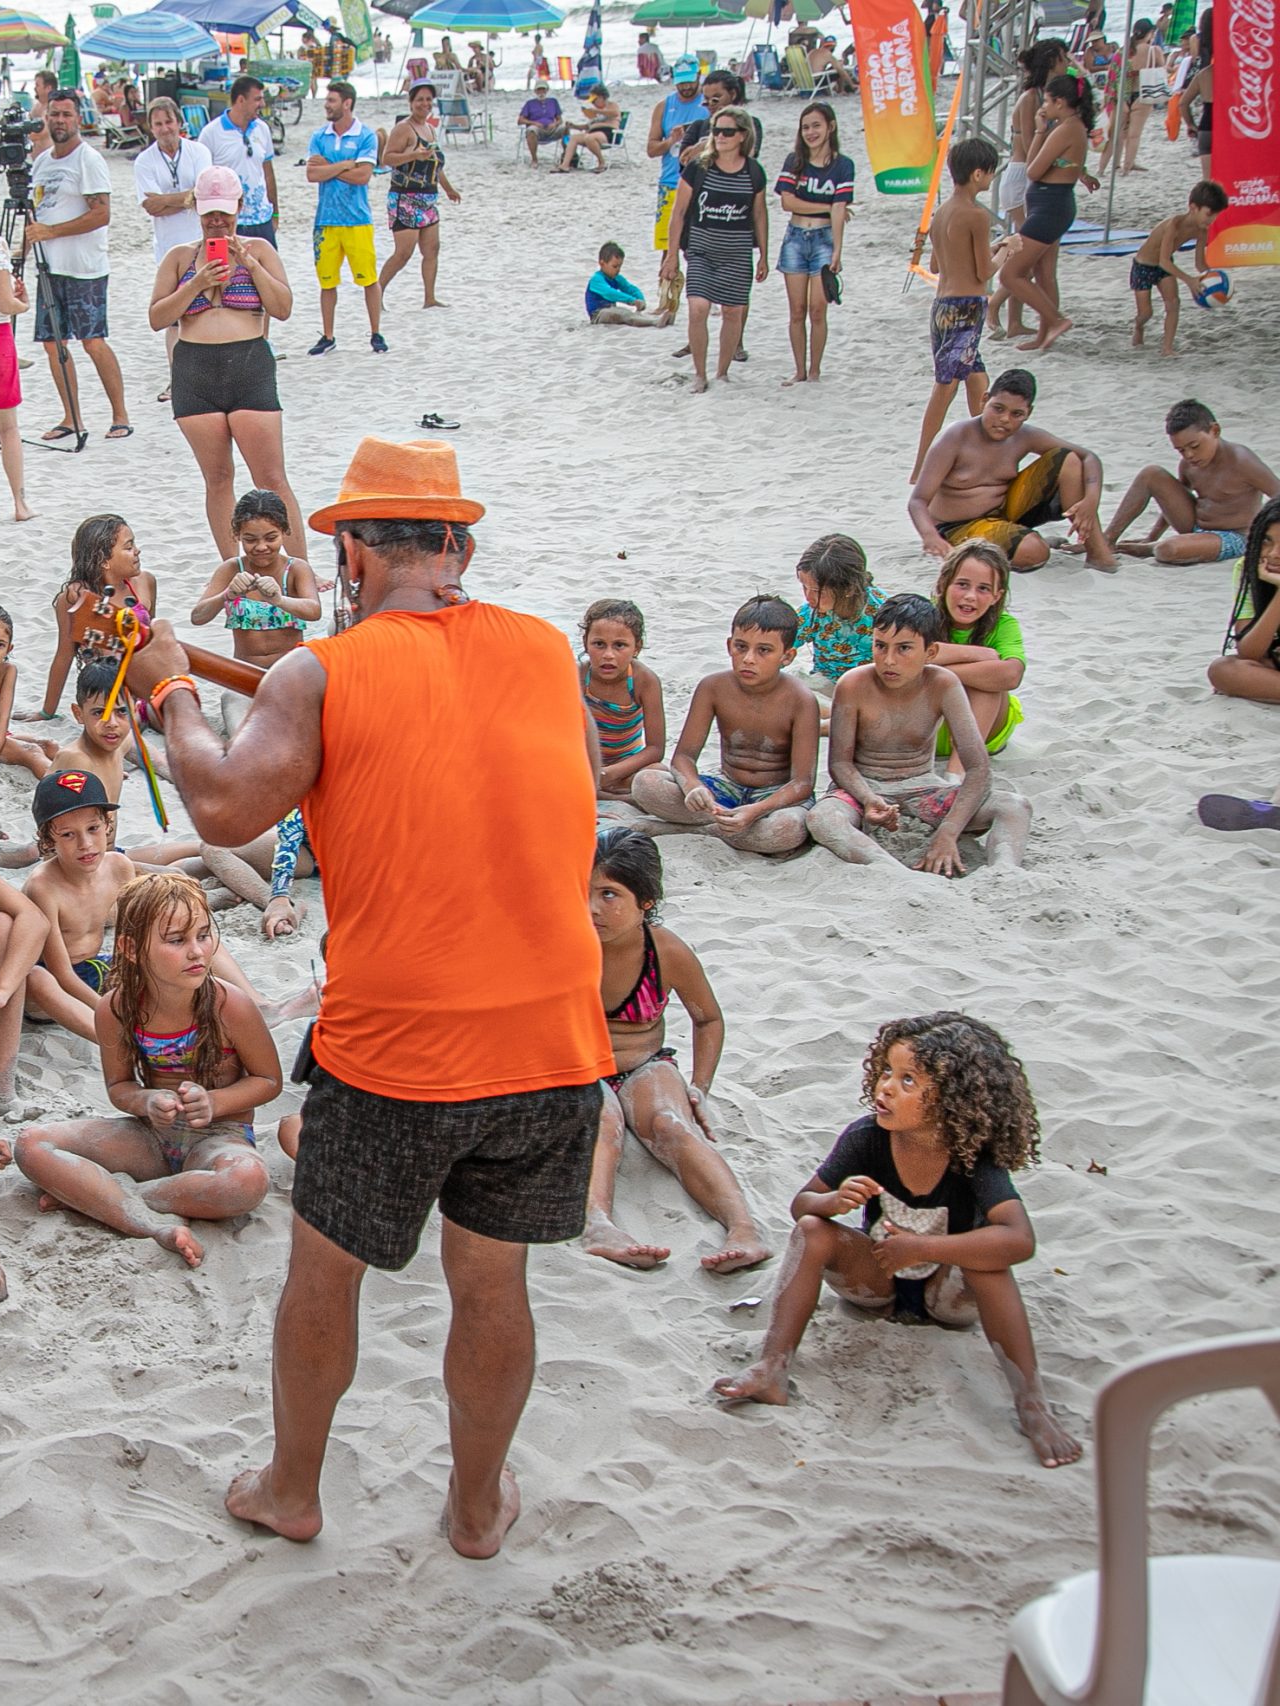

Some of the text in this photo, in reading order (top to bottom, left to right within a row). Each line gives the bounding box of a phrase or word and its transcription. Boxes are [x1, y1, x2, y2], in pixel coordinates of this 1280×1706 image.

[866, 53, 887, 114] VERÃO
[879, 40, 898, 100] MAIOR
[887, 18, 918, 117] PARANÁ
[1228, 0, 1276, 139] Coca-Cola
[698, 191, 749, 222] Beautiful
[799, 176, 836, 196] FILA
